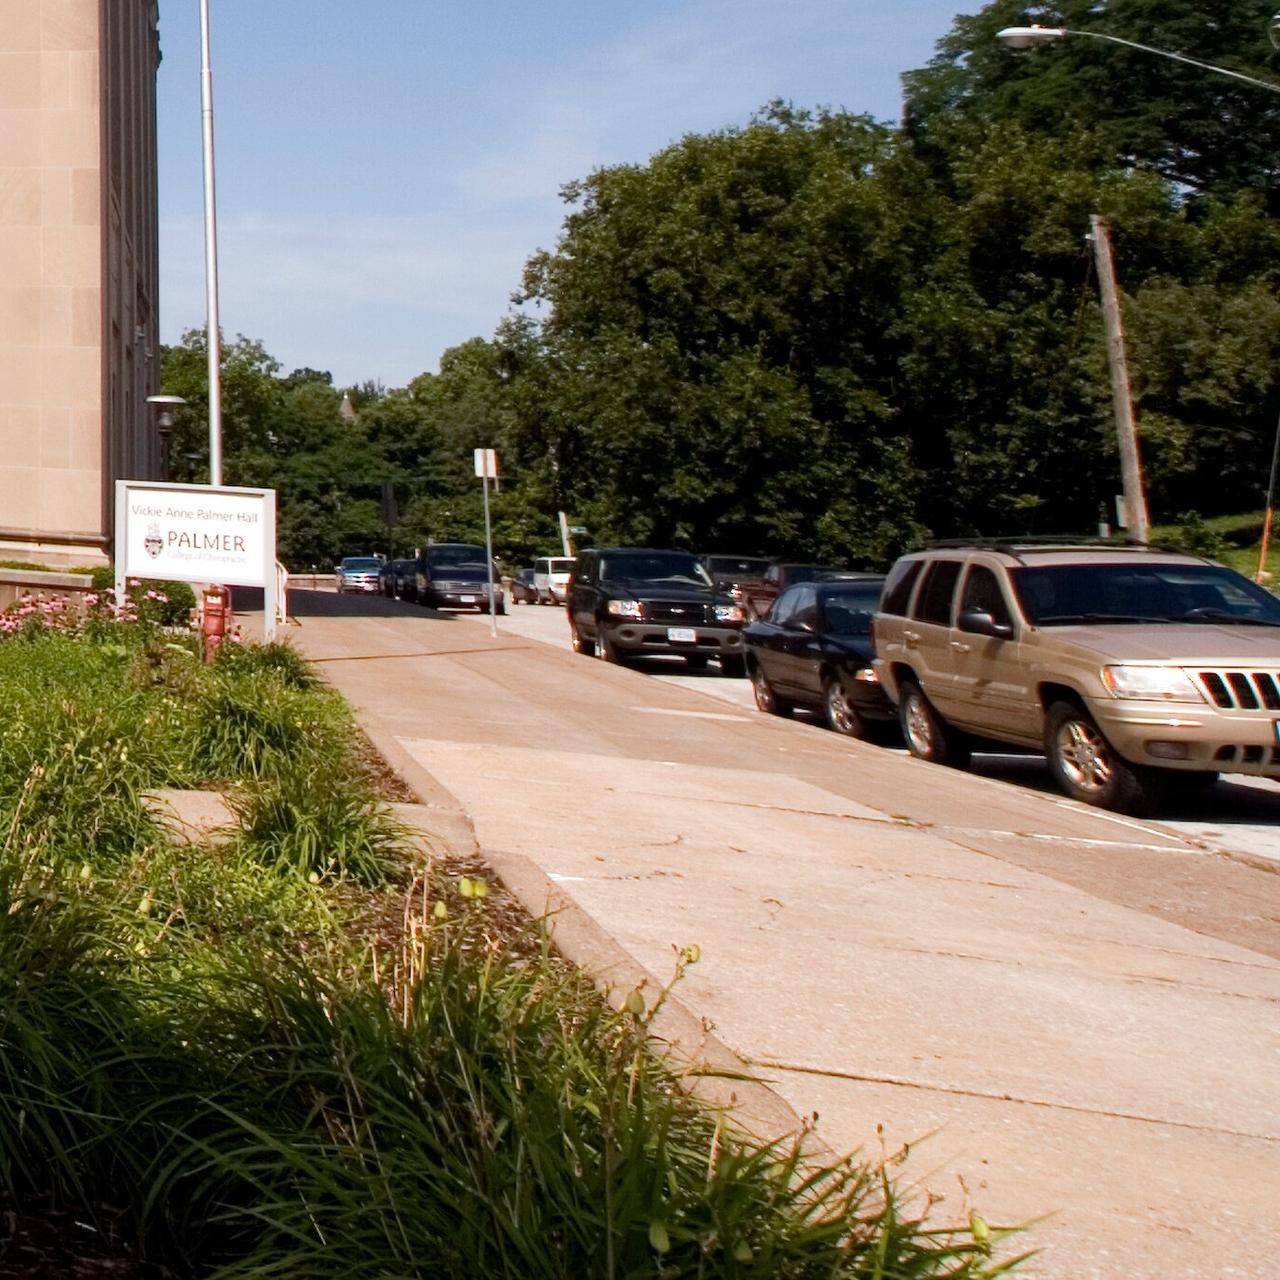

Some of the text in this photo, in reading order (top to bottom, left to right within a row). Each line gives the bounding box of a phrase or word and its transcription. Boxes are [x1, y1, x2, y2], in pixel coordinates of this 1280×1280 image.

[132, 505, 258, 524] Vickie Anne Palmer Hall
[167, 530, 245, 552] PALMER
